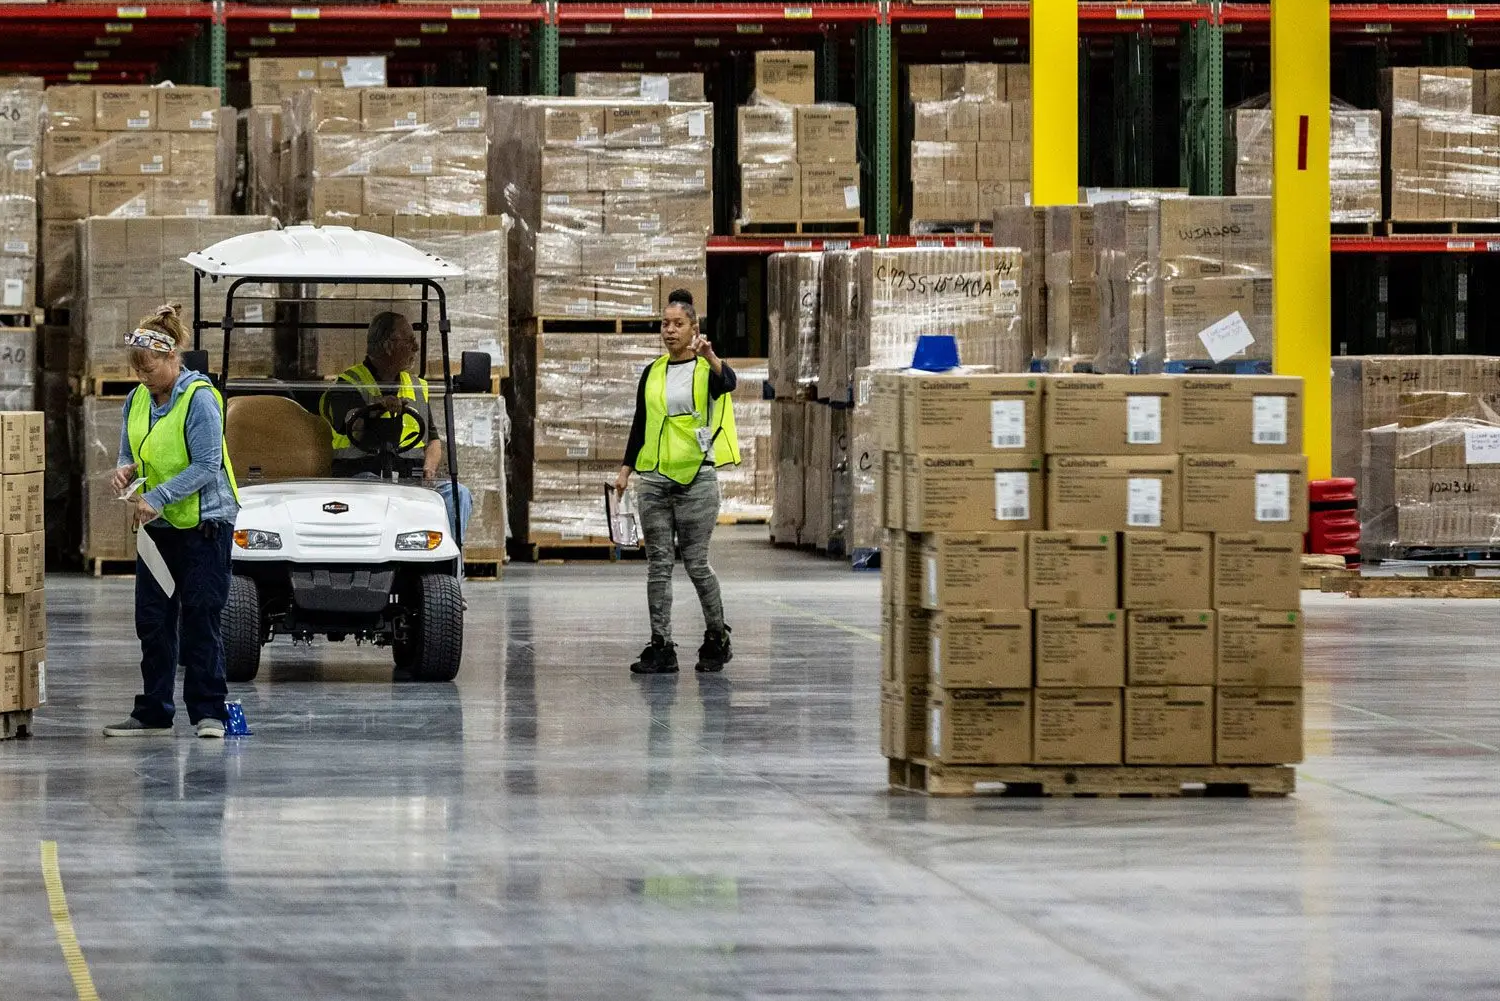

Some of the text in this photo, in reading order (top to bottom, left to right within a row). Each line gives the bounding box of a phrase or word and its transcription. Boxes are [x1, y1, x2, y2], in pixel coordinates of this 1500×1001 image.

[2, 346, 26, 363] 20
[920, 379, 970, 391] Cuisinart
[1054, 380, 1104, 391] Cuisinart
[1182, 380, 1232, 391] Cuisinart
[924, 458, 974, 469] Cuisinart
[1057, 458, 1108, 469] Cuisinart
[1187, 458, 1236, 469] Cuisinart
